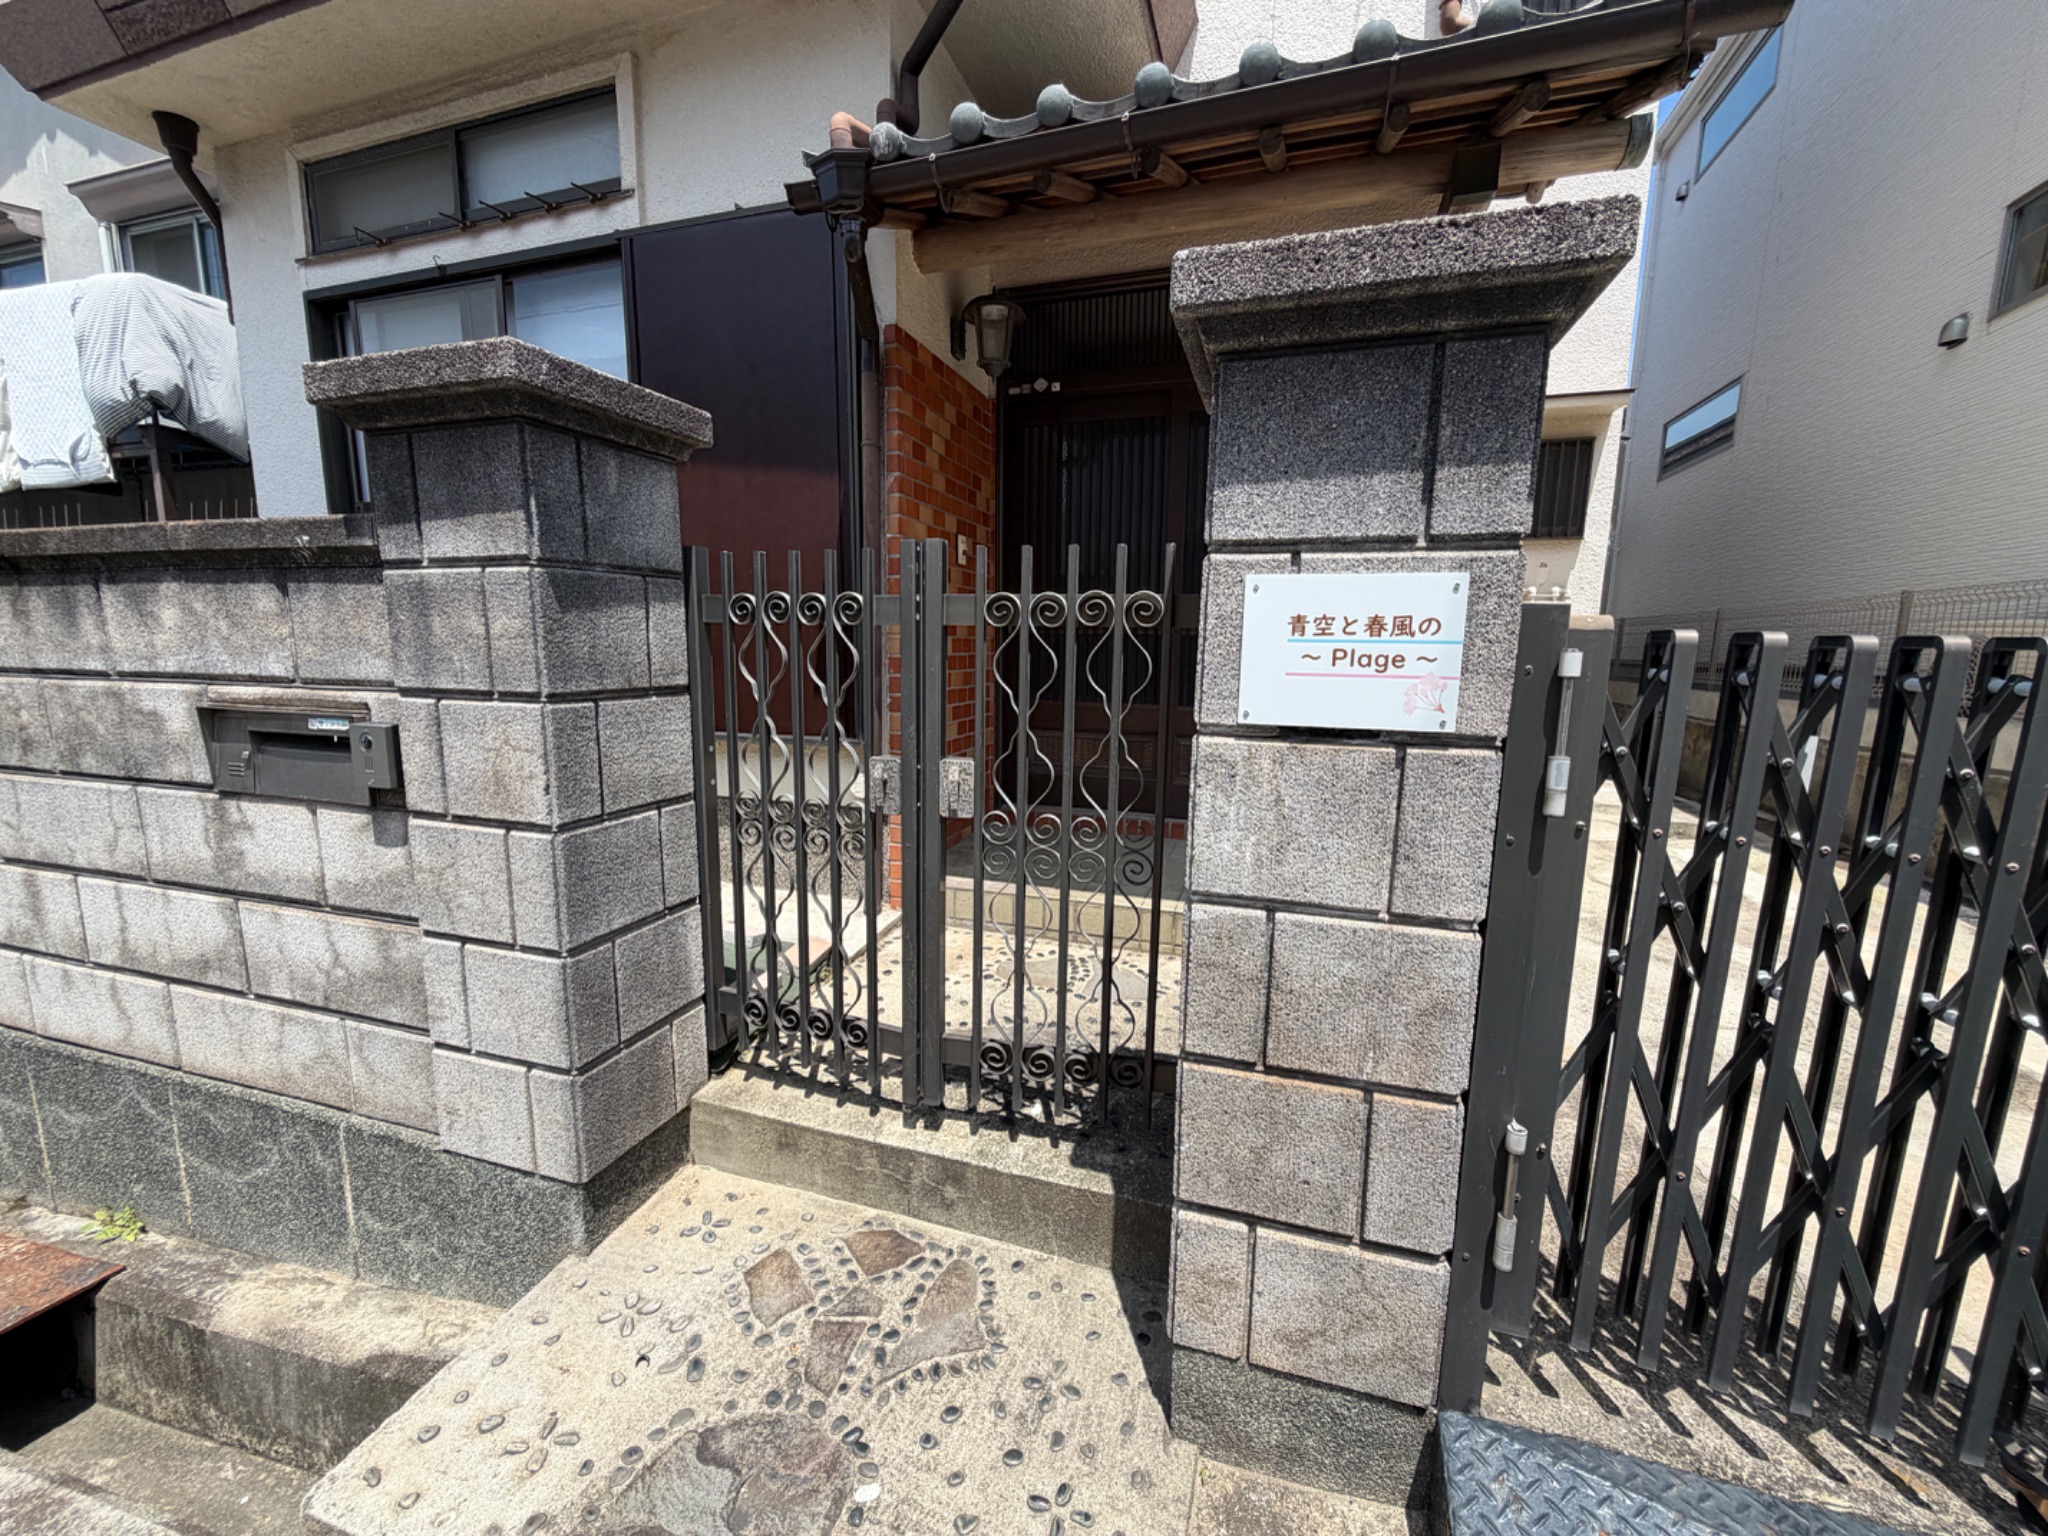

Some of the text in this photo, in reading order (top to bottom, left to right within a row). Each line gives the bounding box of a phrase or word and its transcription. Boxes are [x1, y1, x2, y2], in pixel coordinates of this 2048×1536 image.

[1287, 614, 1442, 637] 青空と春風の
[1332, 648, 1406, 673] Plage
